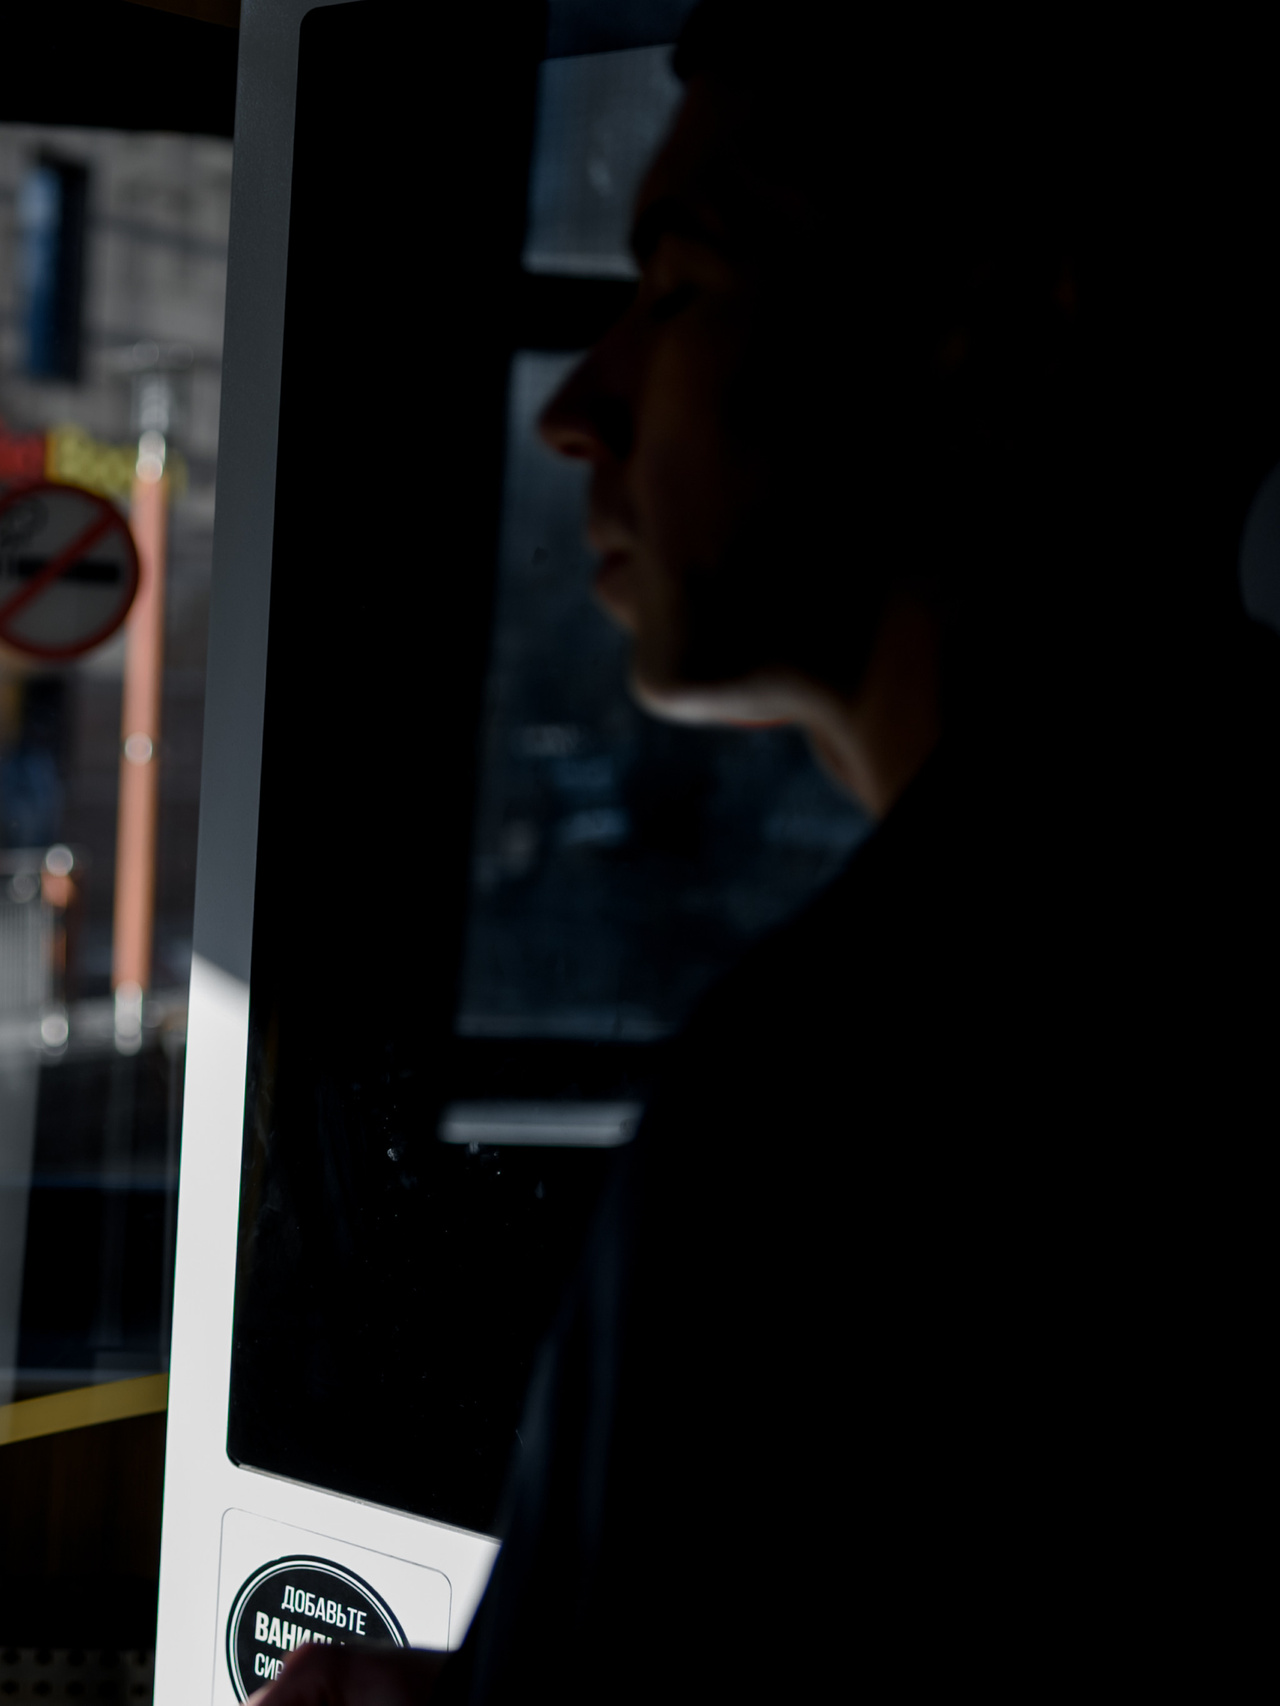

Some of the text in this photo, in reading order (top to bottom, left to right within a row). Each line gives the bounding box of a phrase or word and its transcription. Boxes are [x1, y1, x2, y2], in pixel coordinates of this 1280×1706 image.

[254, 1610, 346, 1652] ВАНИ
[281, 1585, 367, 1636] ДОБАВЬТЕ
[254, 1652, 285, 1681] СИР
